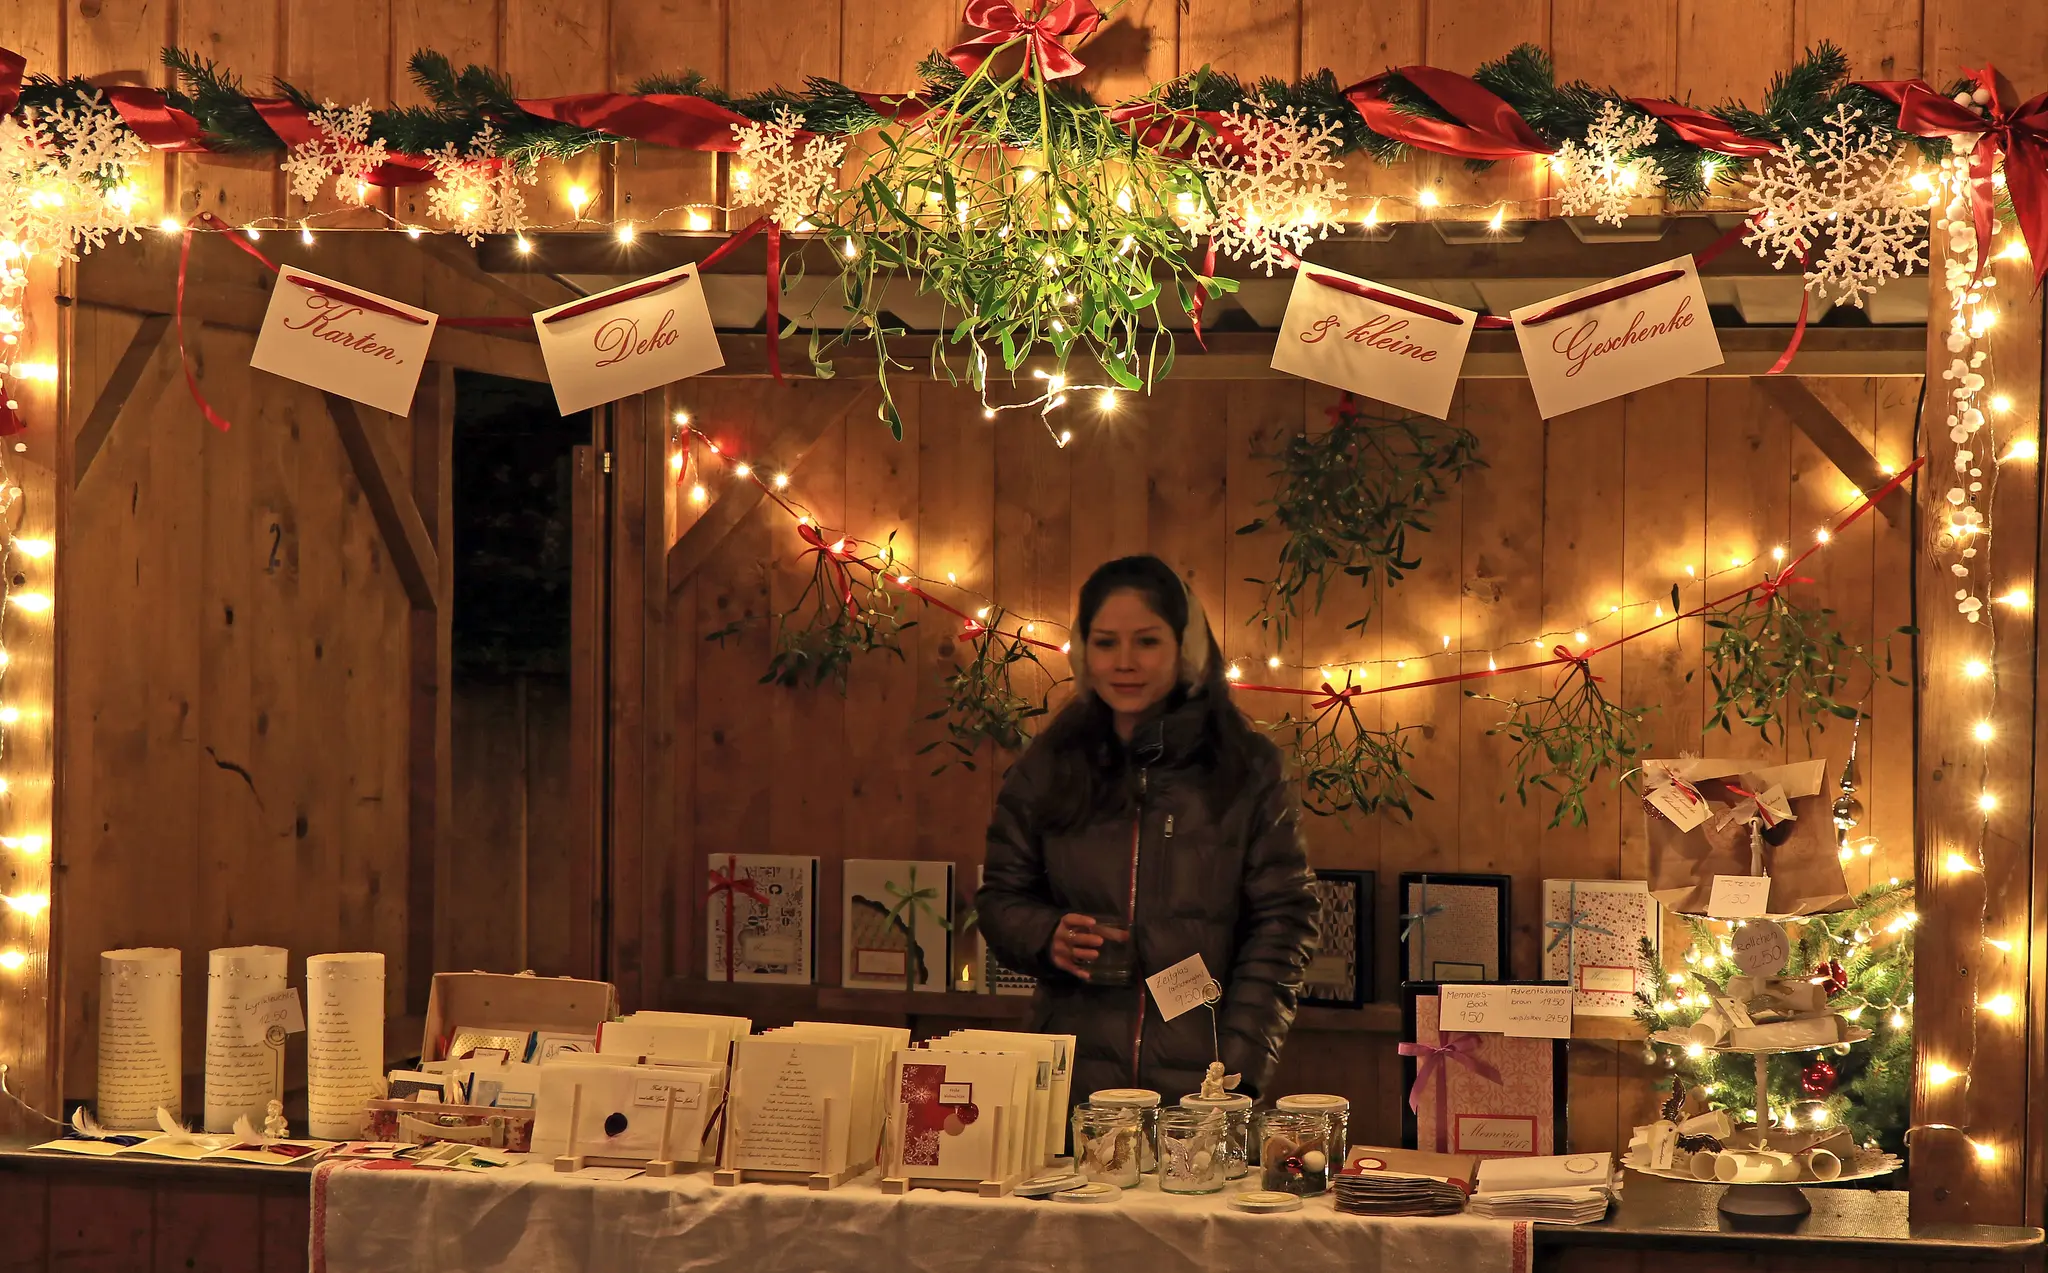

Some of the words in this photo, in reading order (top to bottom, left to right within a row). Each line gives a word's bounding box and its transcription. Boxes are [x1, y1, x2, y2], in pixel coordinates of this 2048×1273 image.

[283, 294, 403, 365] Karten,
[593, 308, 680, 368] Deko
[1344, 313, 1438, 362] kleine
[1552, 296, 1695, 377] Geschenke
[1749, 945, 1782, 969] 2.50
[1156, 966, 1189, 989] Zeitglas
[1446, 991, 1492, 1000] Memories-
[1466, 1000, 1489, 1009] Book
